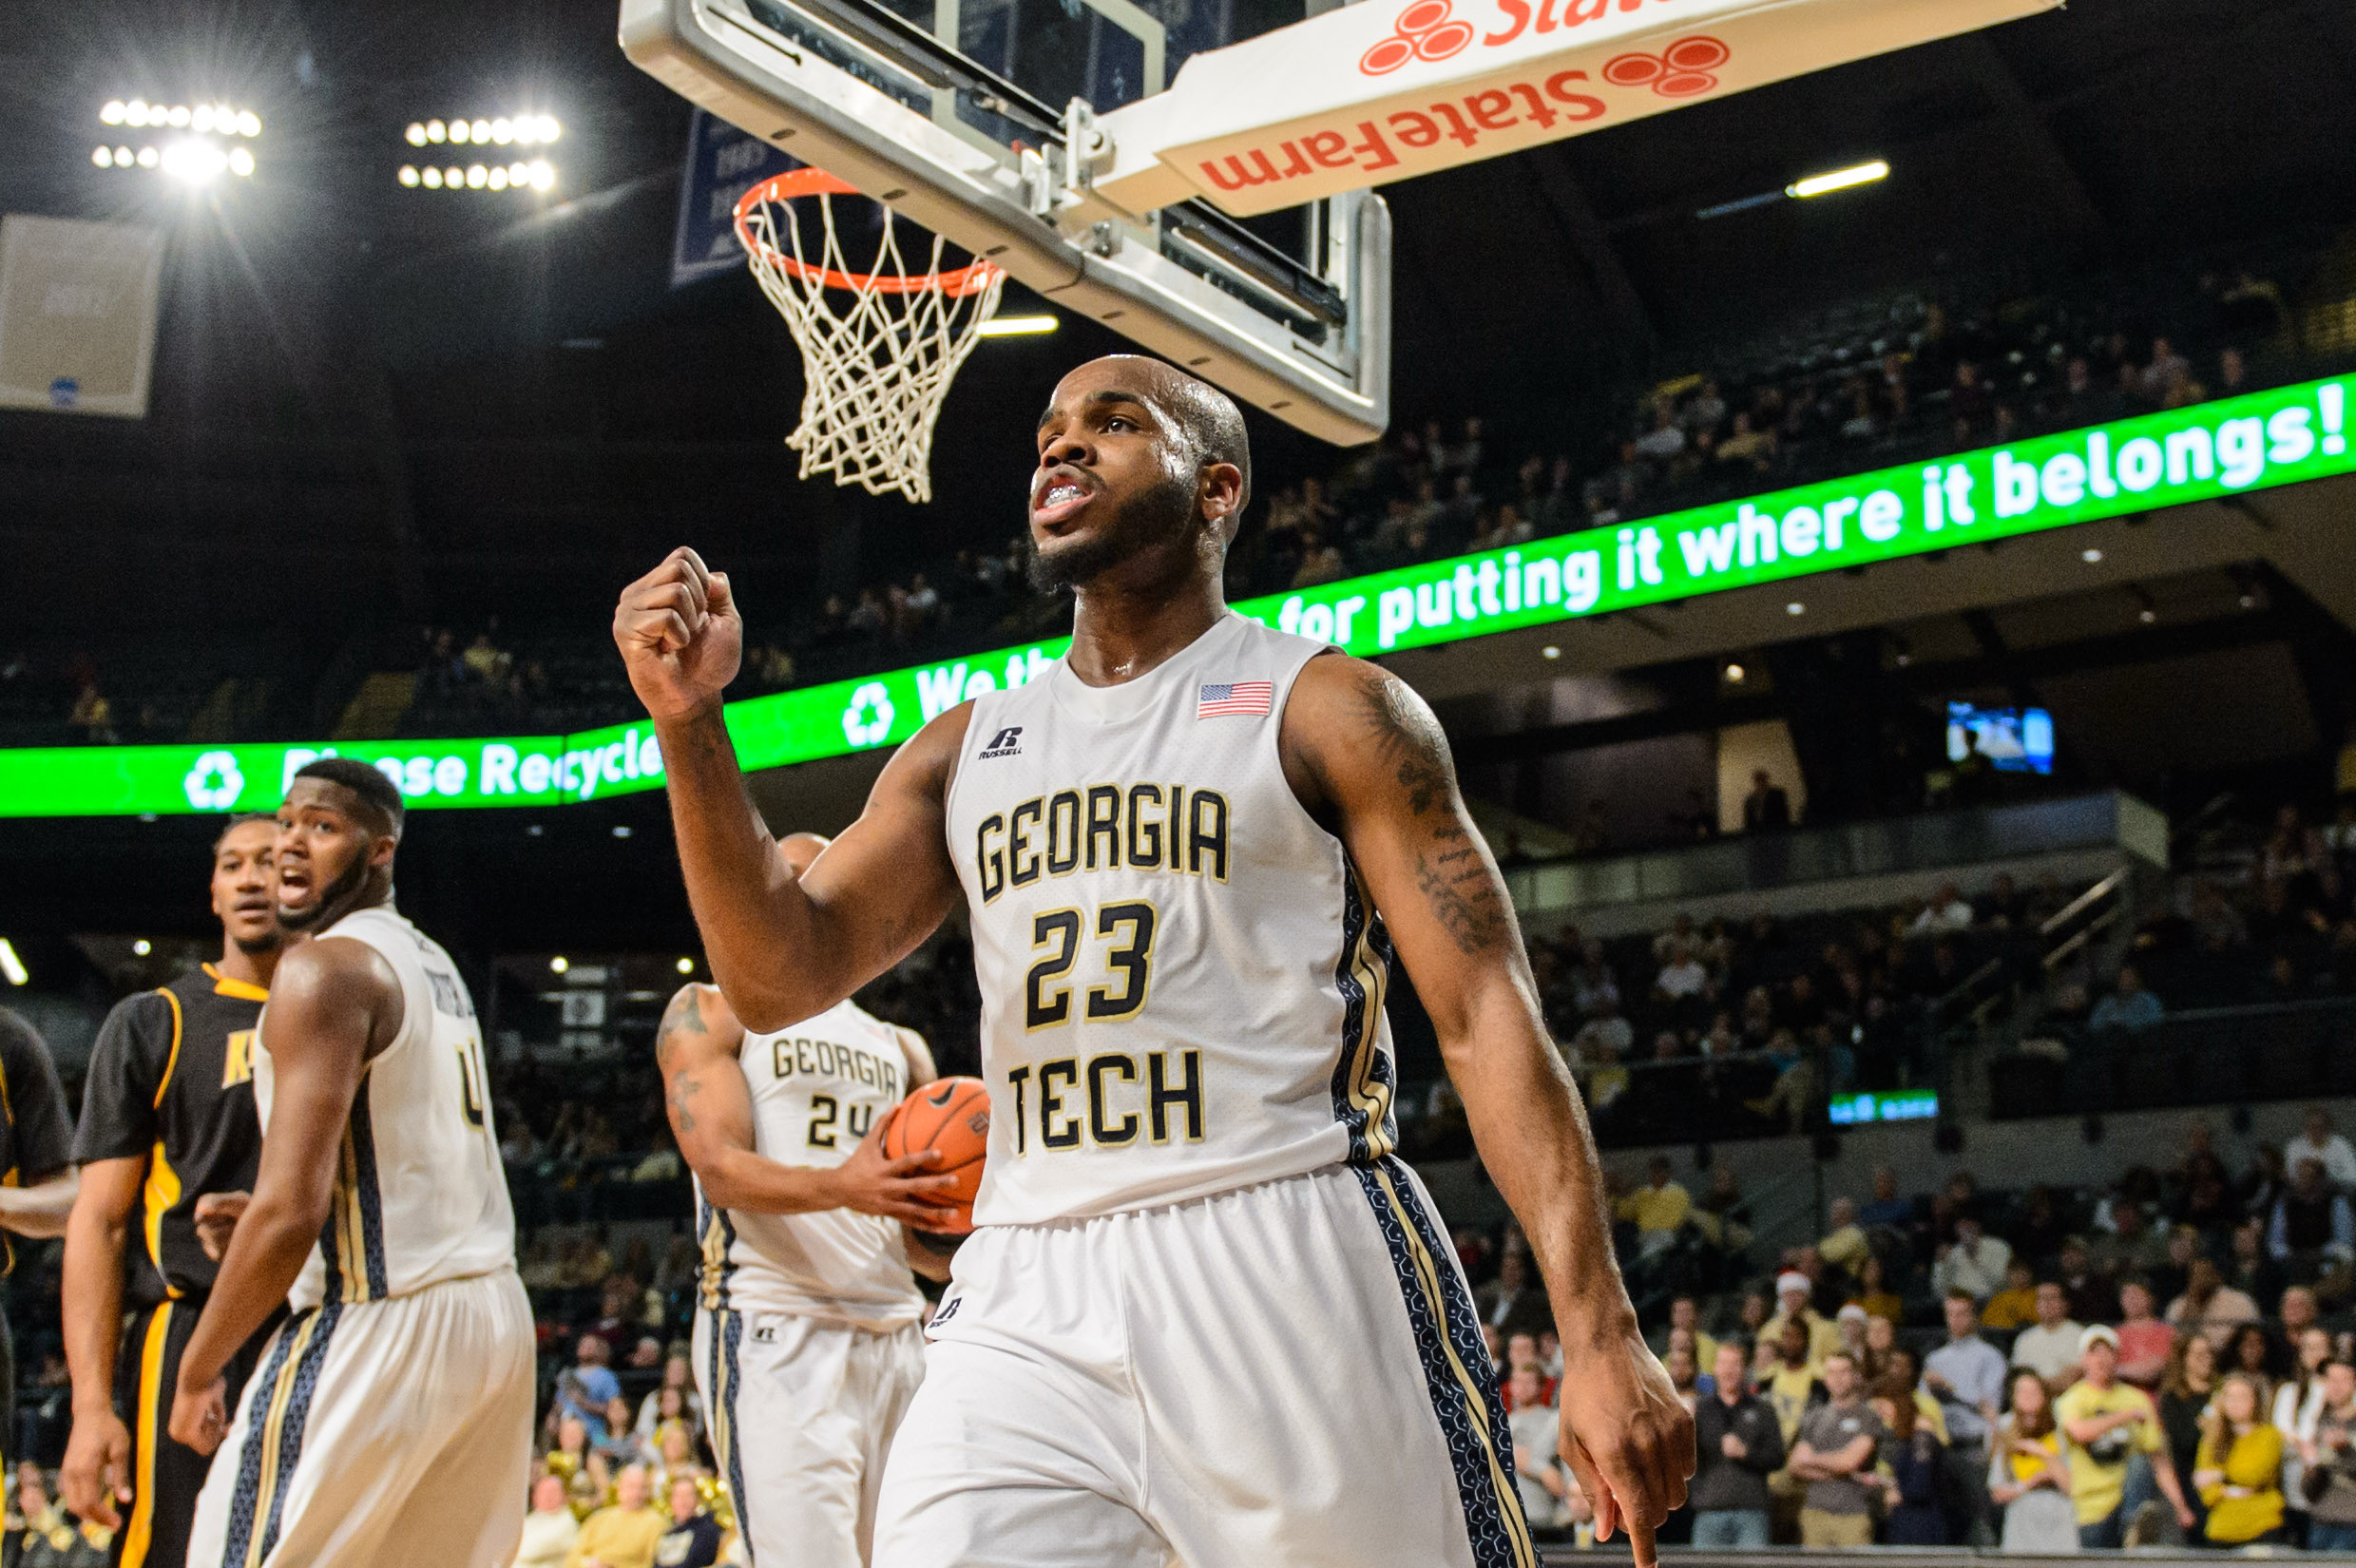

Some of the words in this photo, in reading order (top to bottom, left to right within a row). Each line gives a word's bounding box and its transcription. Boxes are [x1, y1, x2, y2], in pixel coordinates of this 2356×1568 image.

[915, 662, 996, 723] We
[1278, 595, 1366, 645] for
[1379, 551, 1599, 649] putting
[1618, 527, 1662, 590] it
[1678, 490, 1903, 576] where
[1924, 464, 1975, 531] it
[1993, 383, 2346, 518] belongs!
[282, 748, 467, 796] Pase
[480, 729, 665, 800] Recycle
[978, 747, 1023, 760] RUSSELL
[976, 781, 1232, 907] GEORGIA
[1025, 898, 1159, 1034] 23
[773, 1037, 898, 1096] GEORGIA
[1007, 1049, 1206, 1157] TECH
[806, 1094, 873, 1151] 24
